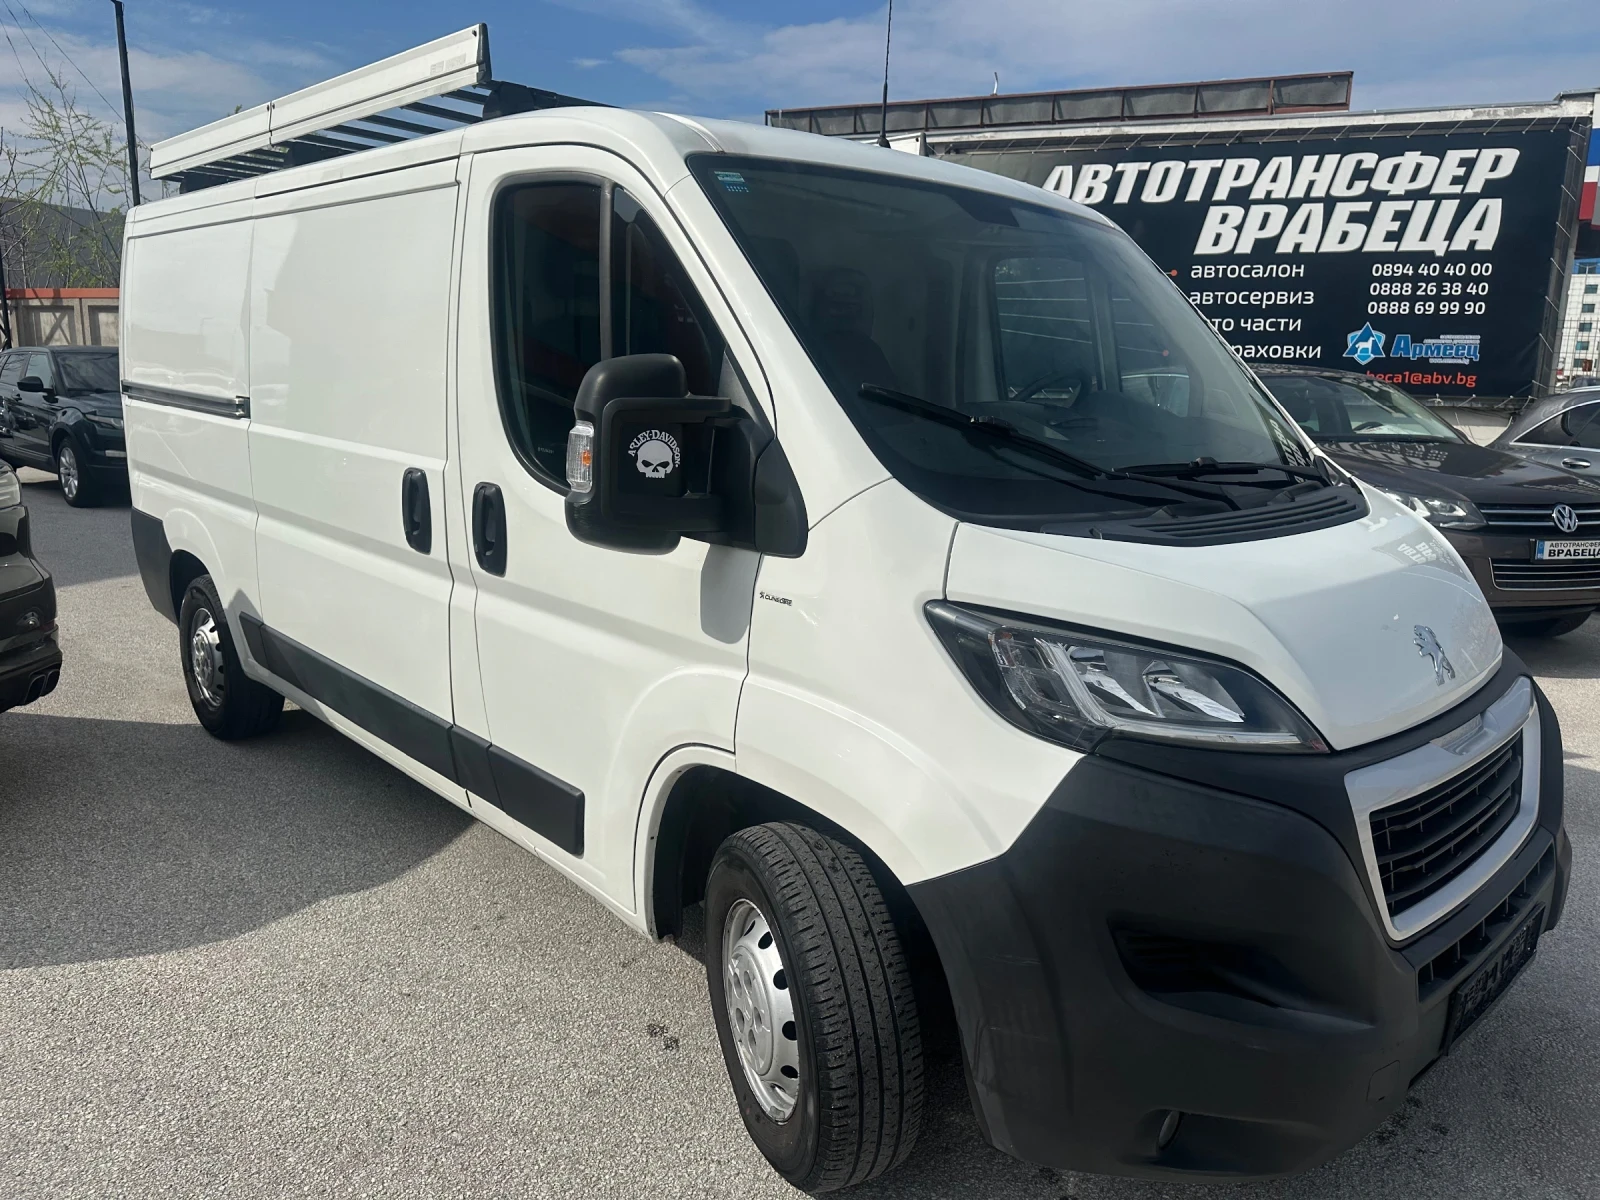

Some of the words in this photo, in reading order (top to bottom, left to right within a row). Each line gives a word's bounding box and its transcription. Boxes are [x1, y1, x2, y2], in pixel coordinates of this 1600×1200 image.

[1041, 147, 1520, 205] АВТОТРАНСФЕР
[1193, 198, 1503, 257] ВРАБЕЦА
[1190, 264, 1305, 279] автосалон
[1372, 263, 1414, 276] 0894
[1418, 263, 1440, 276] 40
[1444, 263, 1466, 276] 40
[1470, 263, 1493, 276] 00
[1369, 282, 1412, 295] 0888
[1416, 282, 1437, 295] 26
[1440, 282, 1462, 295] 38
[1466, 282, 1489, 295] 40
[1189, 291, 1315, 309] автосервиз
[1367, 301, 1410, 315] 0888
[1414, 301, 1435, 315] 69
[1439, 301, 1460, 315] 99
[1464, 301, 1486, 315] 90
[1240, 318, 1302, 332] части
[1390, 334, 1480, 361] Армеец
